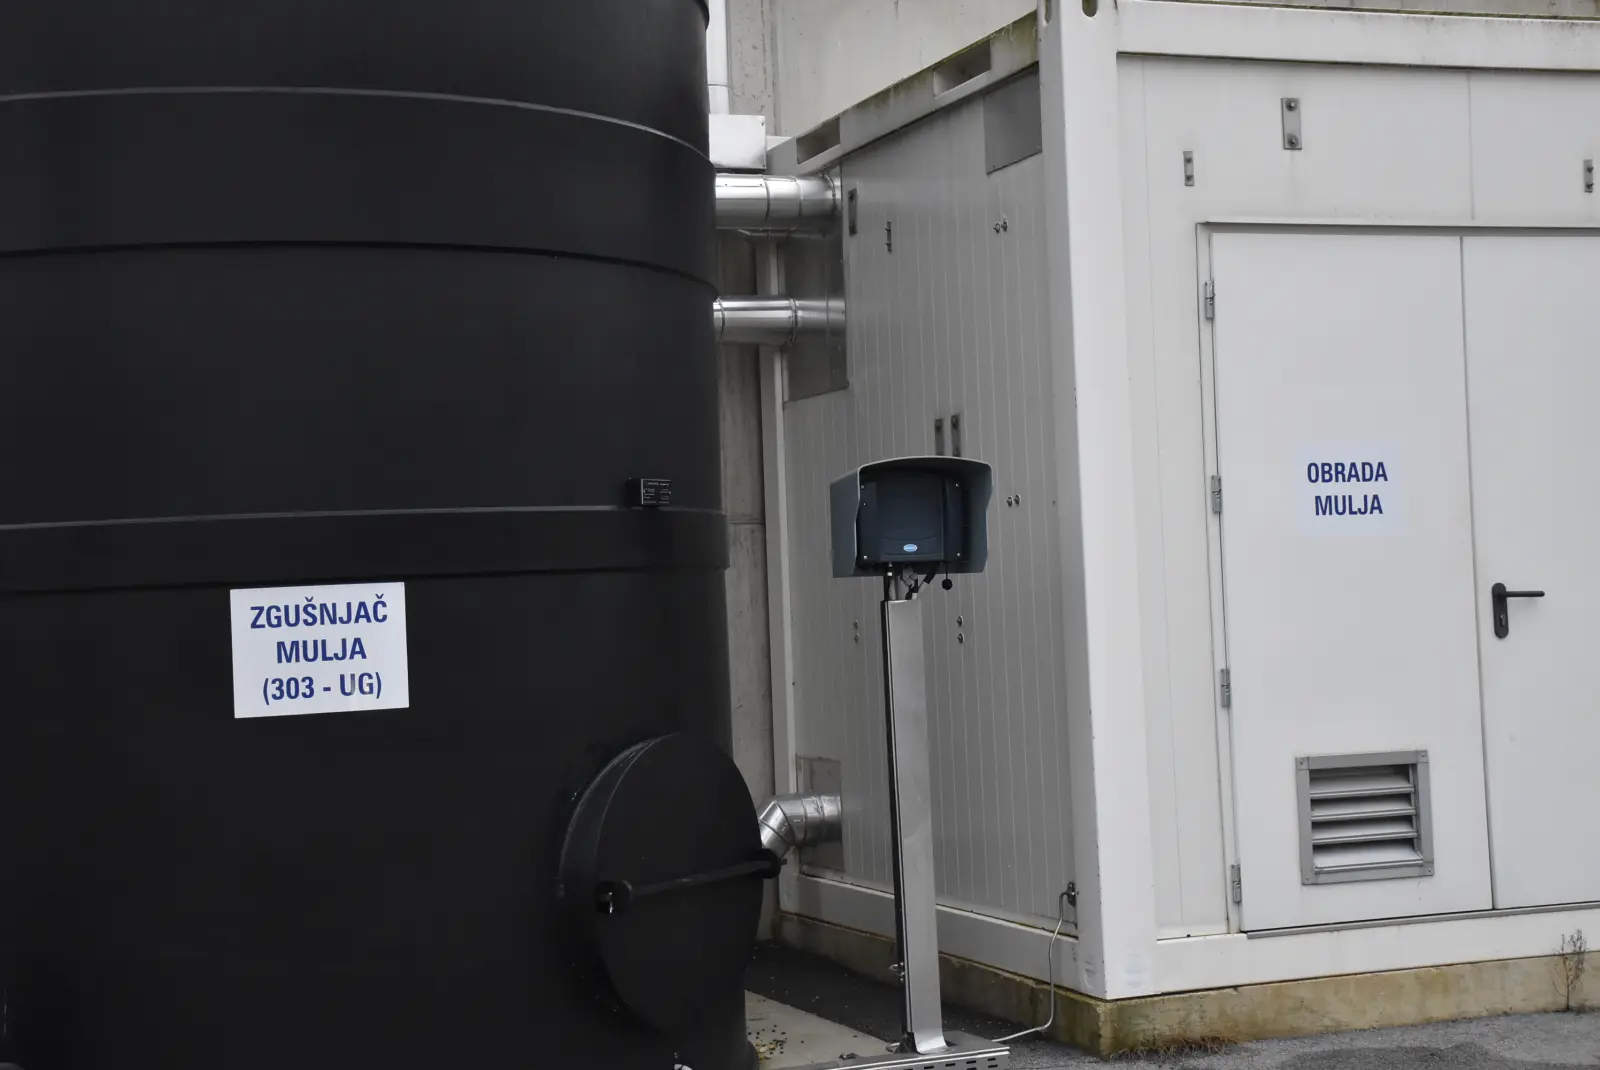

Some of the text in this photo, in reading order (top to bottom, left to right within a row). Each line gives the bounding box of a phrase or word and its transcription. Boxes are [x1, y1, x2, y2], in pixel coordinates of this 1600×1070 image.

[1307, 462, 1388, 483] OBRADA
[1315, 494, 1383, 516] MULJA
[250, 593, 387, 629] ZGUŠNJAČ
[276, 637, 367, 664] MULJA
[263, 676, 315, 706] (303
[339, 672, 382, 699] UG)
